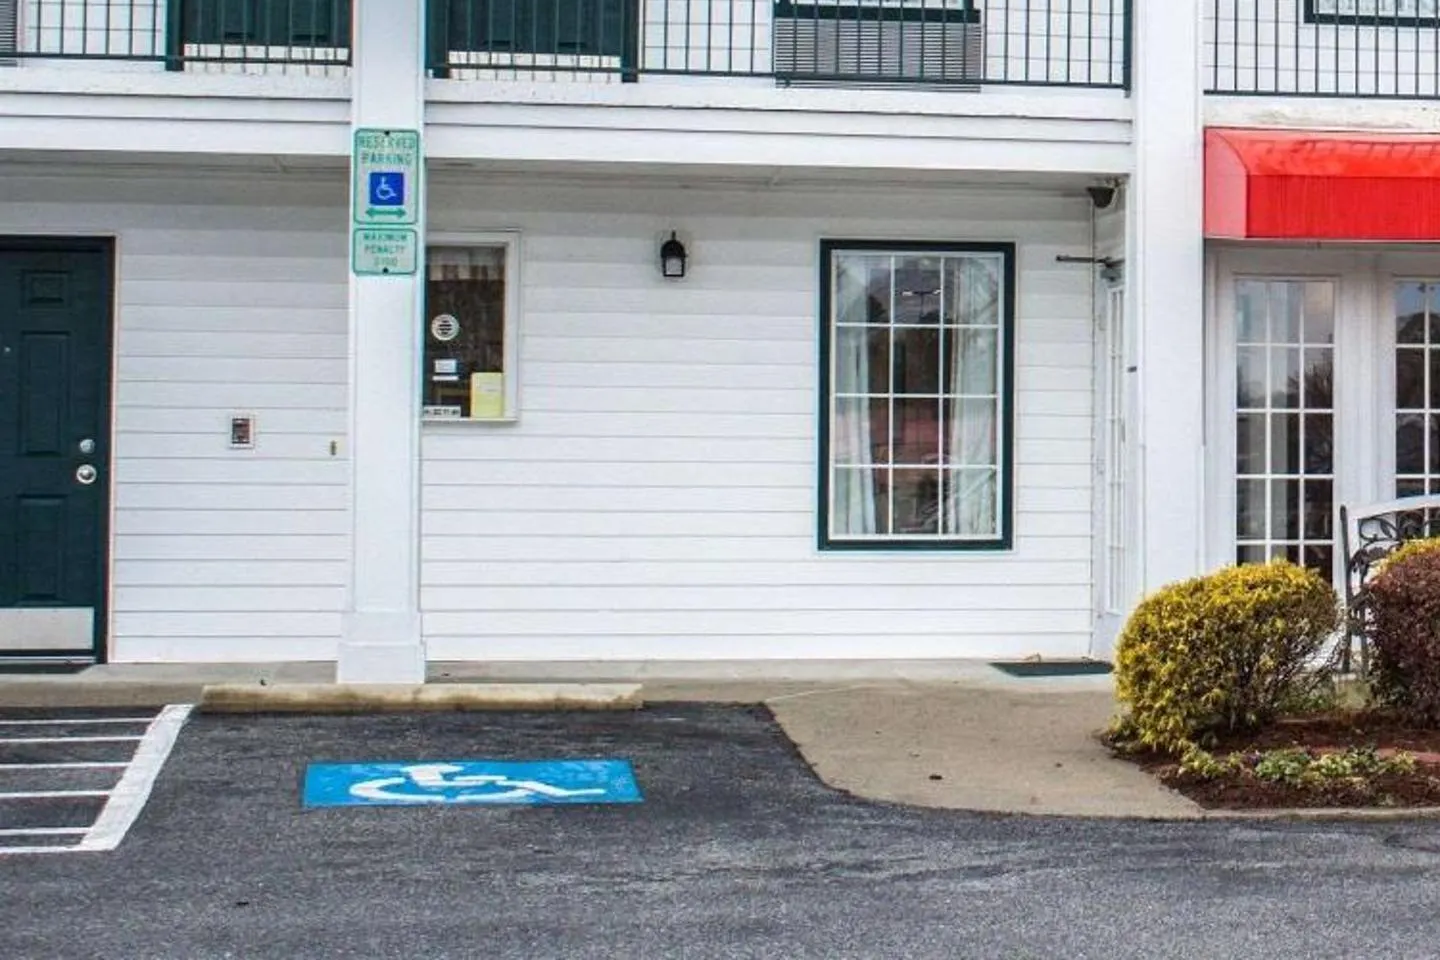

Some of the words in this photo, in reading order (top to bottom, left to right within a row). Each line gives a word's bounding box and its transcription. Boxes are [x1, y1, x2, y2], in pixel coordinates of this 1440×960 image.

[358, 135, 415, 148] RESERVED
[361, 152, 412, 165] PARKING
[363, 232, 407, 241] MAXIMUM
[364, 244, 405, 254] PENALTY
